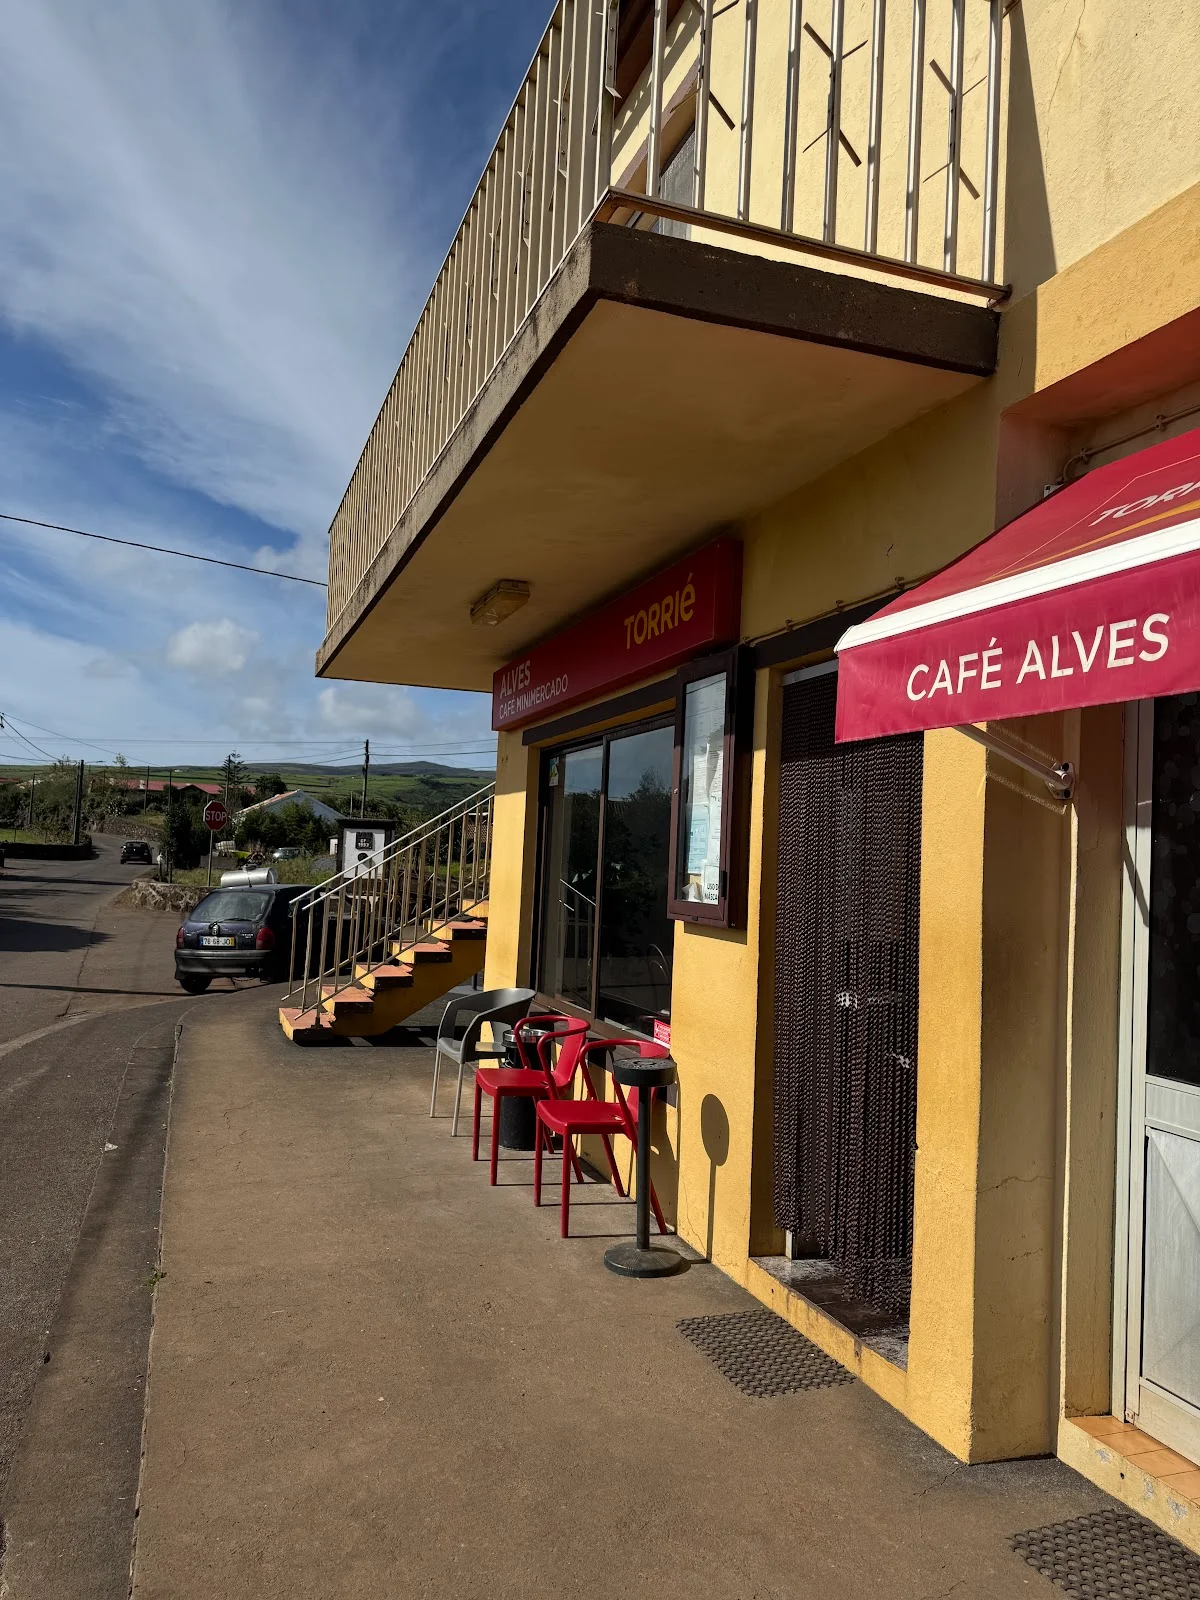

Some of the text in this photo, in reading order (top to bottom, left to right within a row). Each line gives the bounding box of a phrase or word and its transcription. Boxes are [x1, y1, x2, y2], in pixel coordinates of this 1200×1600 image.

[1088, 481, 1200, 527] TOR
[500, 660, 531, 699] ALVES
[906, 613, 1170, 702] CAFÉ ALVES
[499, 673, 569, 720] CAFÉ MINIMERCADO
[205, 810, 227, 822] STOP
